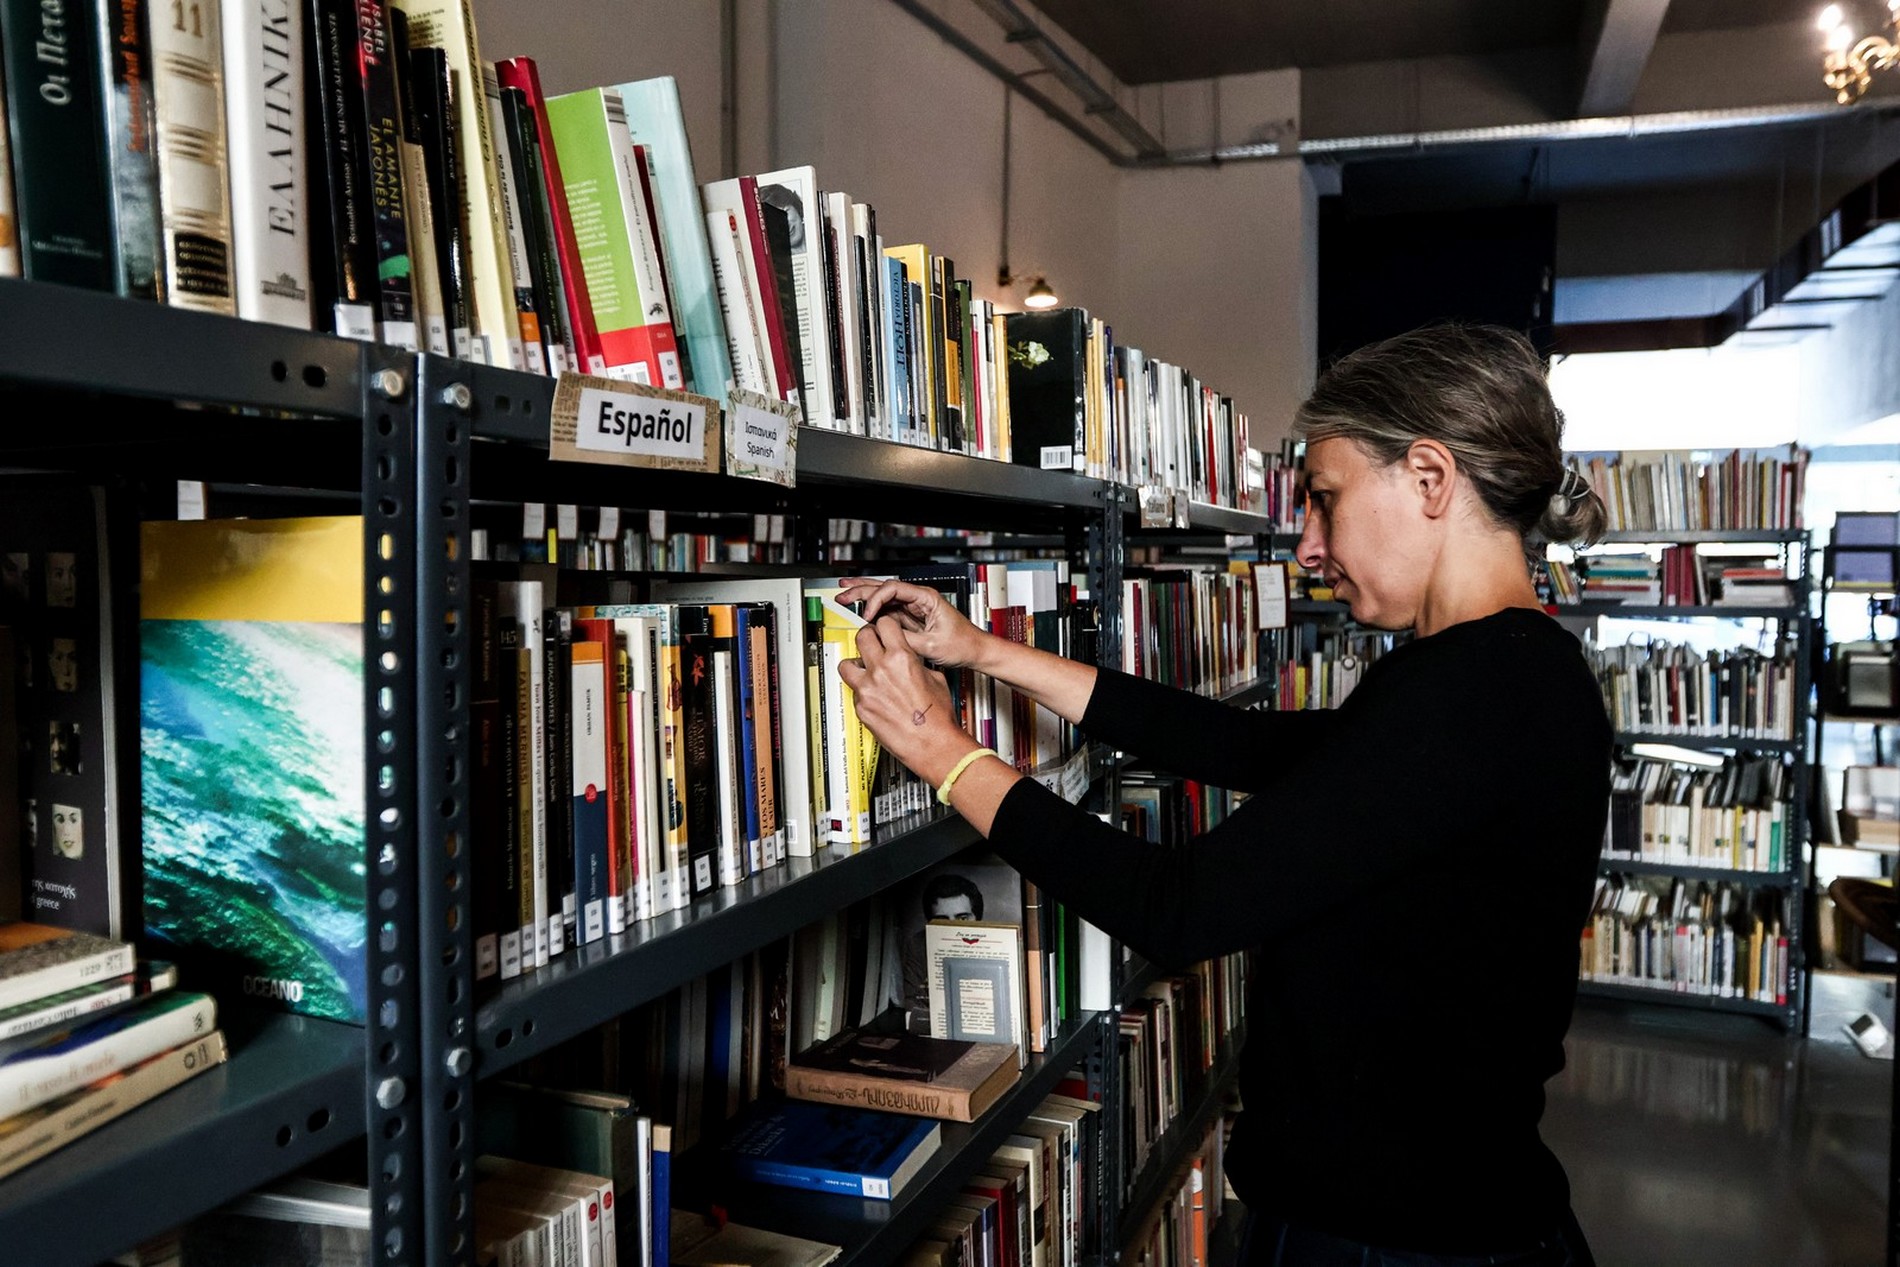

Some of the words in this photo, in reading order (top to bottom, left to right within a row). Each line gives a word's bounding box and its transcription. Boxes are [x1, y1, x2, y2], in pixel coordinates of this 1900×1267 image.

[172, 0, 203, 38] 11
[372, 4, 385, 53] ISABEL
[39, 75, 72, 105] Οι
[261, 0, 296, 237] ΕΛΛΗΝΙΚ
[382, 118, 395, 135] EL
[341, 161, 353, 197] Arenas
[368, 124, 388, 207] JAPONÉS
[385, 142, 402, 219] AMANTE
[344, 197, 357, 244] Reinaldo
[752, 186, 765, 230] BORGES
[891, 271, 902, 318] VICTORIA
[892, 319, 906, 370] HOLT
[597, 401, 692, 446] Español
[745, 421, 778, 442] Ισπανικά
[746, 441, 775, 460] Spanish
[517, 670, 527, 720] FATEMA
[517, 724, 528, 785] MERNISSI
[758, 766, 767, 804] MARES
[759, 805, 768, 829] LOS
[36, 897, 60, 910] greece
[243, 975, 302, 1003] OCEANO
